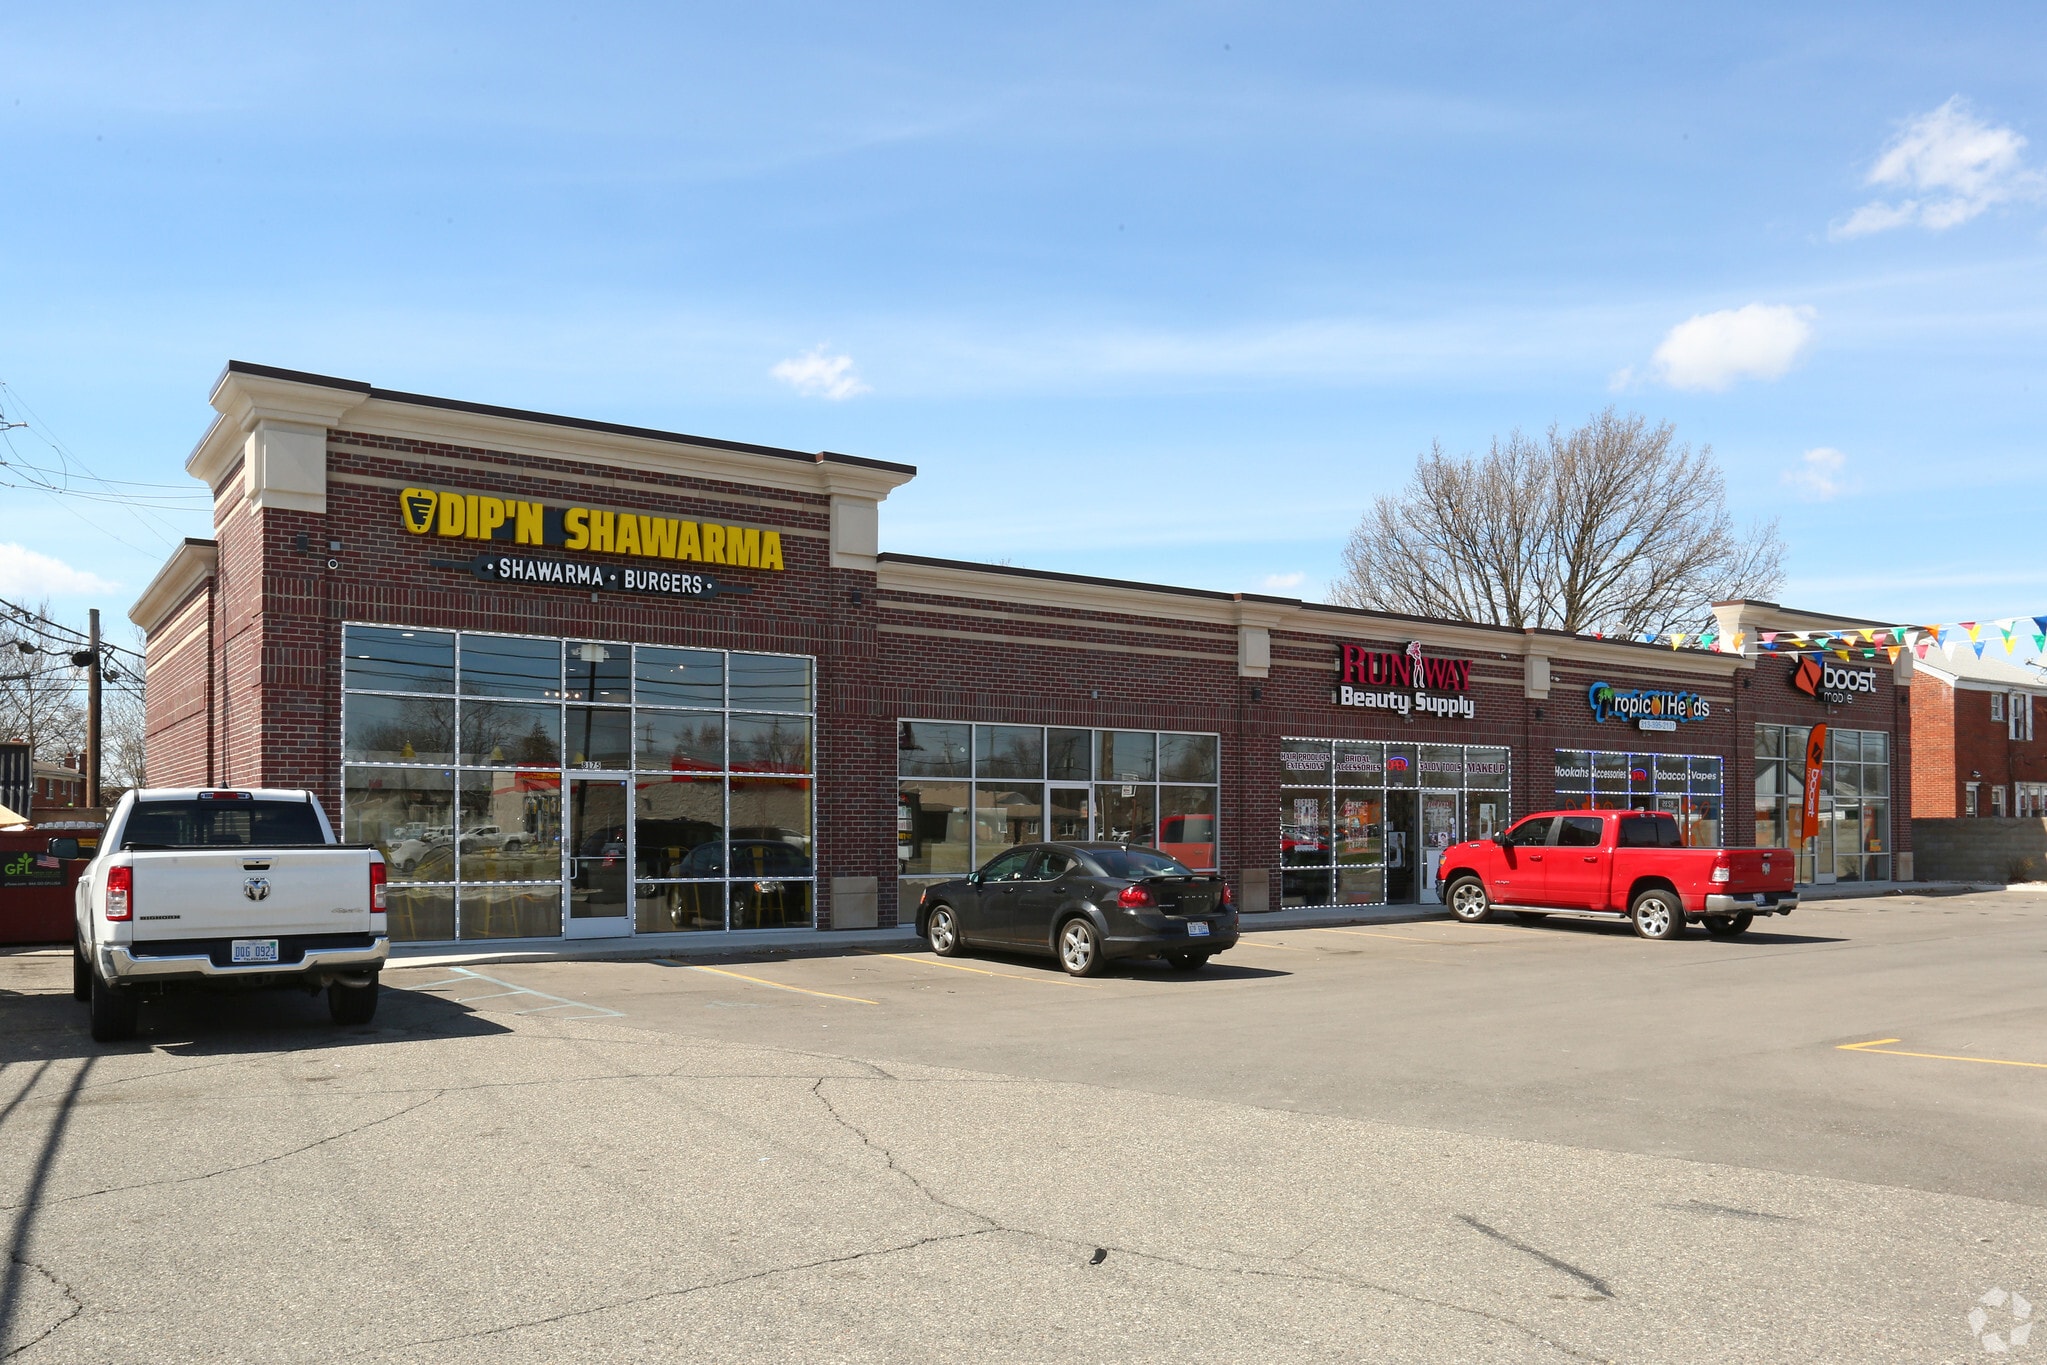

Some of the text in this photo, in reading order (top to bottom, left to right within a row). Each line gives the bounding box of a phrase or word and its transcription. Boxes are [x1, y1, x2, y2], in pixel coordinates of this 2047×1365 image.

[438, 491, 785, 570] DIP'N SHAWARMA
[499, 558, 702, 594] SHAWARMA BURGERS
[1824, 661, 1876, 693] boost
[1340, 686, 1475, 719] Beauty Supply
[1823, 691, 1853, 704] mobe
[1345, 754, 1370, 762] BRIDAL
[1286, 761, 1325, 770] EXTENSIONS
[1336, 763, 1381, 772] ACCESSORIES
[1420, 761, 1462, 772] SALON TOOLS
[1467, 762, 1506, 774] MAKEUP
[1554, 766, 1589, 778] Hookahs
[1594, 768, 1627, 779] Accessories
[1654, 769, 1686, 780] Tobacco
[1691, 771, 1717, 781] Vapes
[1808, 769, 1820, 818] boost
[4, 857, 33, 875] GFL
